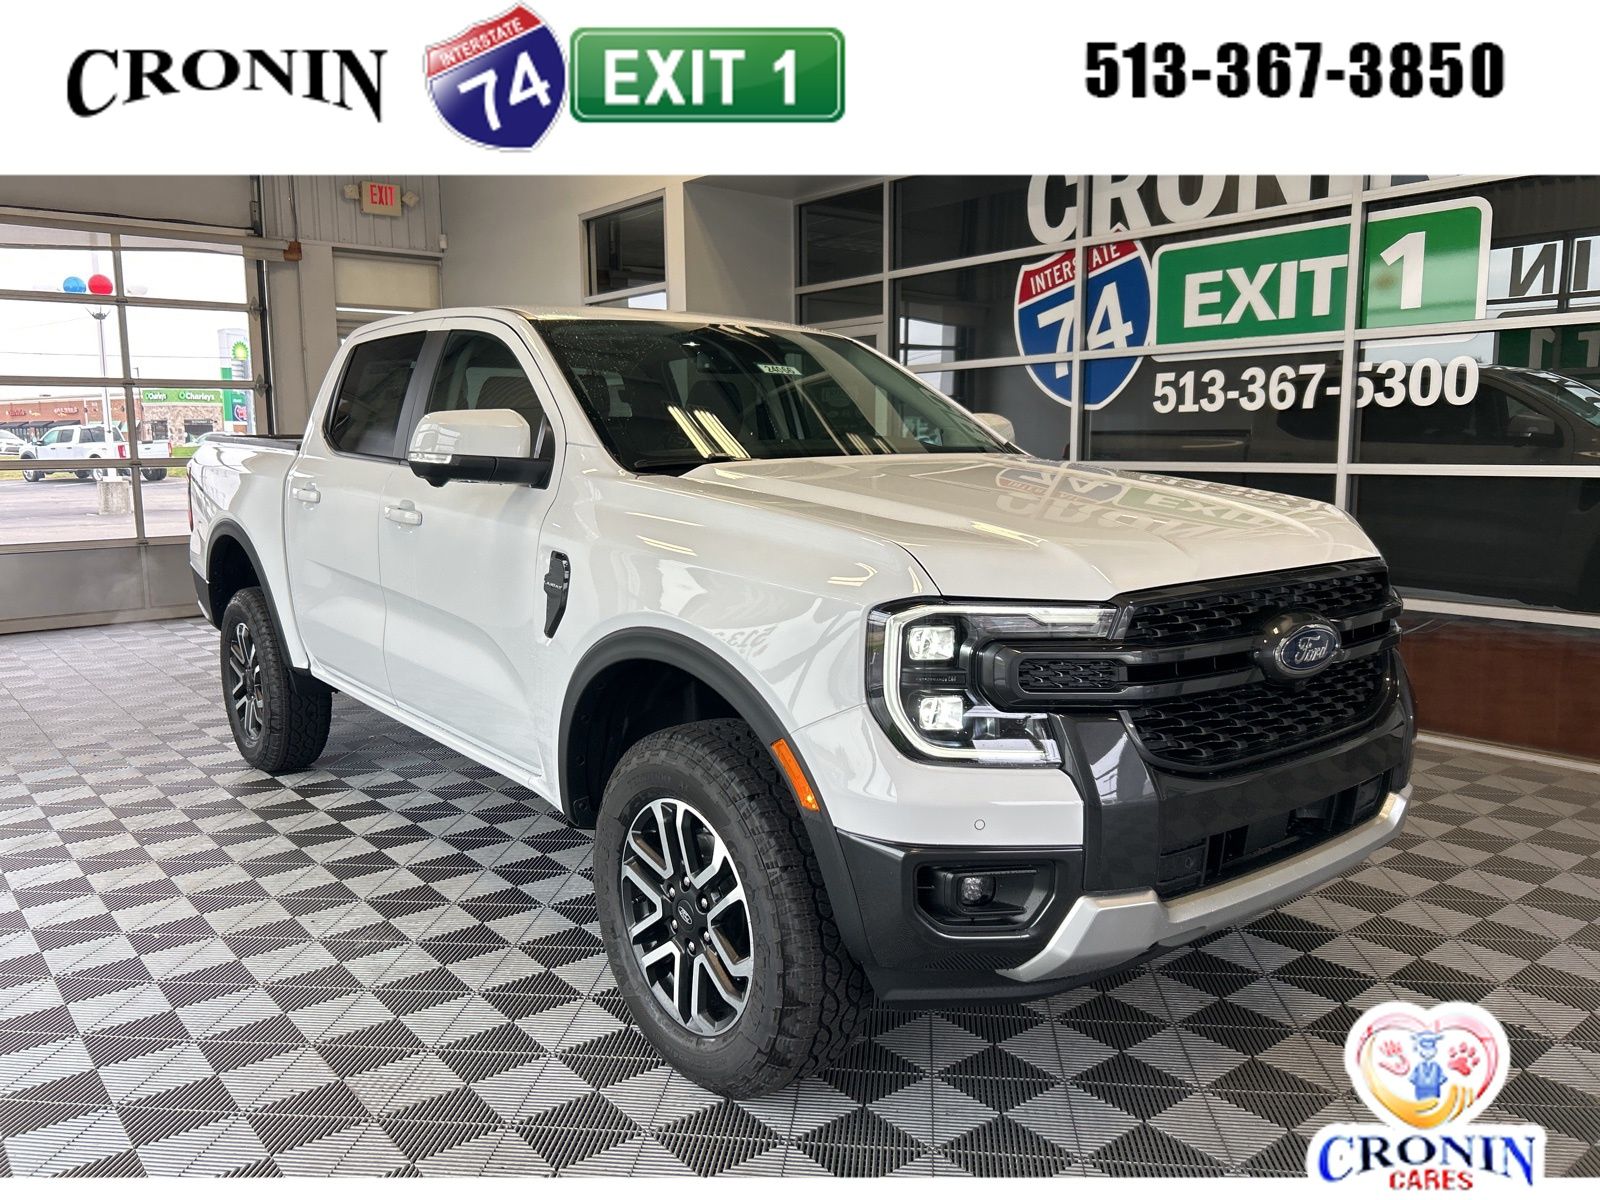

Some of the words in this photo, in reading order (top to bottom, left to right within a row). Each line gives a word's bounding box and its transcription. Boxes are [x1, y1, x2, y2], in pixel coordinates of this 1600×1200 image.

[369, 183, 395, 208] EXIT
[1030, 243, 1121, 296] INTERSATE
[1183, 253, 1349, 329] EXIT
[1380, 230, 1427, 311] 1
[1036, 281, 1135, 380] 74
[185, 391, 215, 402] Charleys
[1152, 355, 1480, 414] 513-367-5300
[1294, 635, 1329, 665] Ford
